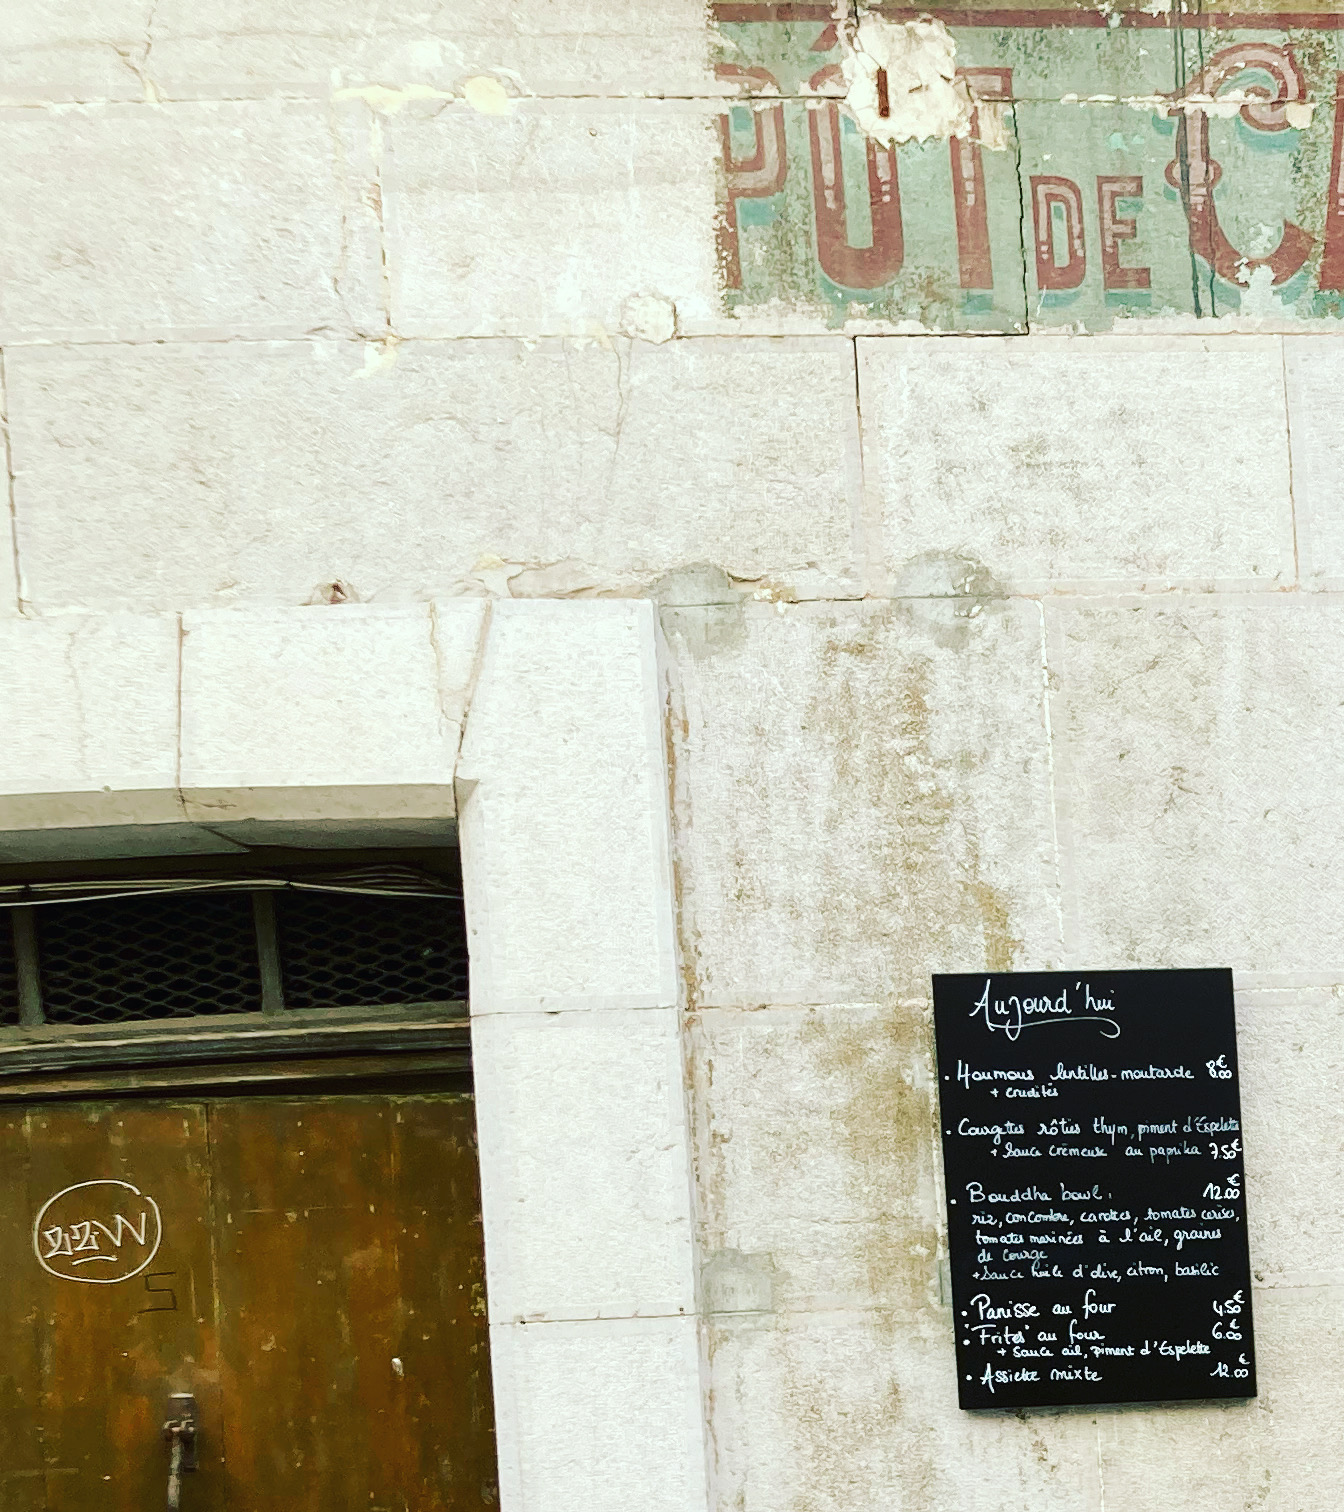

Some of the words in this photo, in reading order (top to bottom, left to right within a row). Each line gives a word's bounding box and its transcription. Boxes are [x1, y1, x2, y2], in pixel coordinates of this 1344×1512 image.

[1030, 175, 1152, 293] DE
[969, 979, 1120, 1040] Aujourd'hui
[957, 1060, 1034, 1089] Houmous
[1006, 1083, 1058, 1098] crudités
[1125, 1146, 1142, 1156] au
[1150, 1142, 1201, 1164] paprika
[966, 1182, 1052, 1203] Bouddha
[1144, 1208, 1196, 1220] tomates
[976, 1230, 1024, 1244] tomates
[1098, 1230, 1110, 1242] à
[1174, 1228, 1221, 1250] graines
[978, 1250, 993, 1262] de
[1175, 1259, 1219, 1276] basilic
[970, 1294, 1040, 1320] Panisse
[1052, 1304, 1072, 1315] au
[1084, 1289, 1116, 1320] four
[1038, 1331, 1057, 1341] au
[1069, 1319, 1105, 1343] four
[1090, 1344, 1134, 1357] piment
[980, 1362, 1040, 1393] Assiette
[1050, 1365, 1102, 1381] mixte
